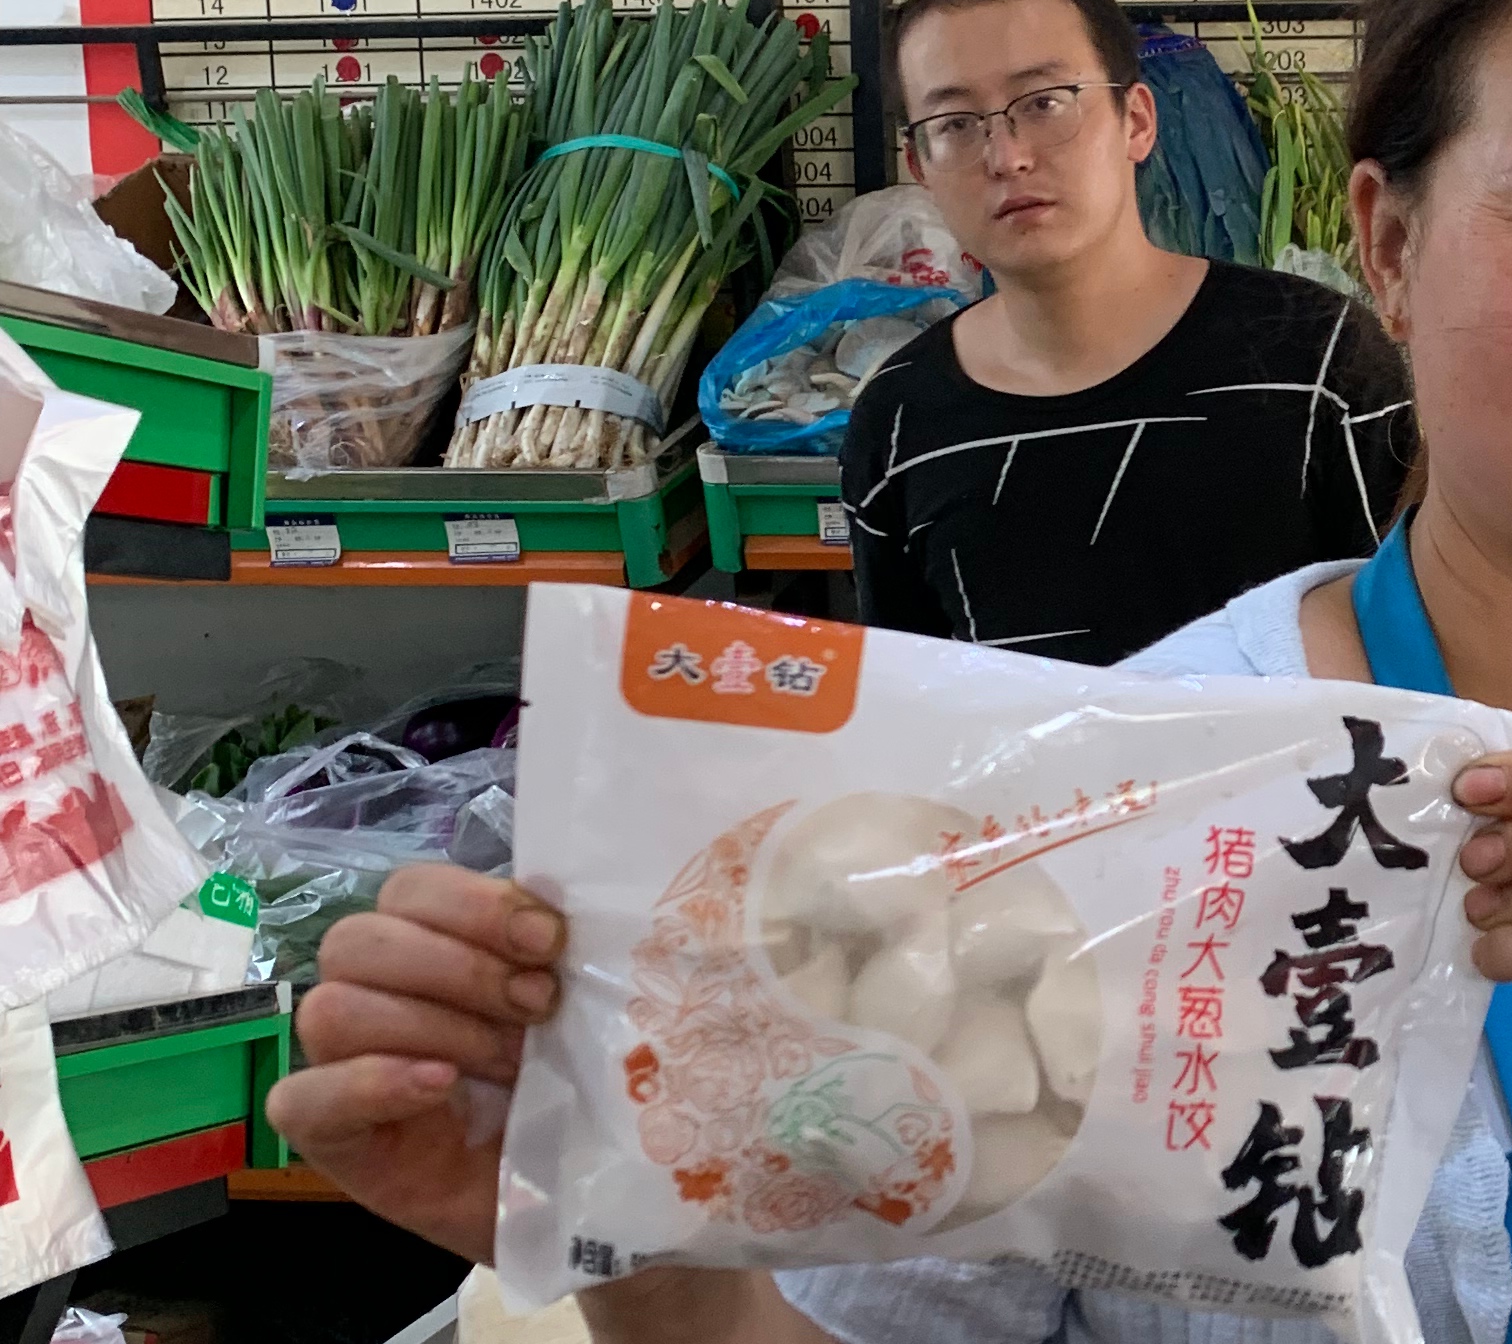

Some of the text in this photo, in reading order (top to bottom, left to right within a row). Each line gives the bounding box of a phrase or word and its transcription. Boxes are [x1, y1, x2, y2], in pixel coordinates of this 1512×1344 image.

[203, 65, 229, 86] 12
[1164, 866, 1181, 901] zhu
[1165, 824, 1256, 1152] 猪肉大葱水饺
[1219, 713, 1430, 1269] 大壹钻
